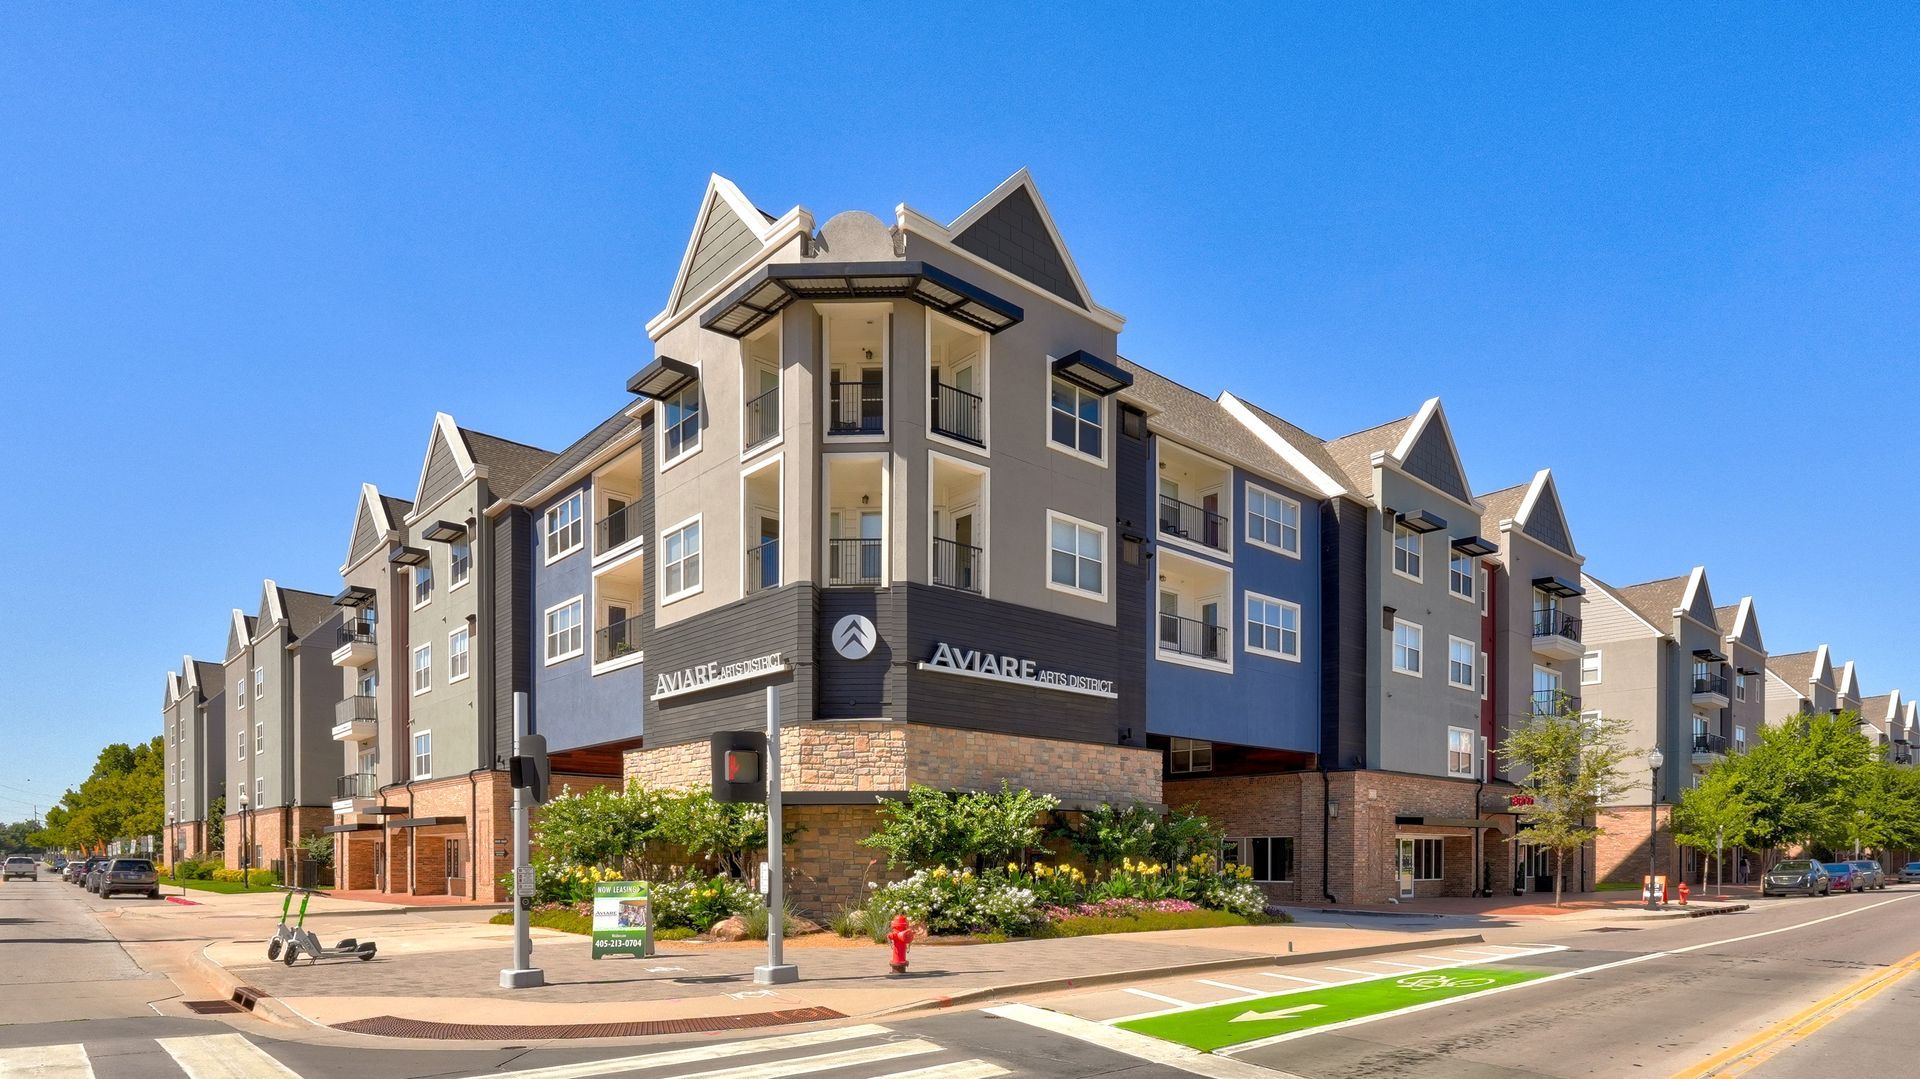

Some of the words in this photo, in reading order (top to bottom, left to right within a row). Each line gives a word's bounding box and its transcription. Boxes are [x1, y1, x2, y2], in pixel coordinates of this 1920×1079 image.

[655, 661, 719, 695] AVIARE
[720, 663, 742, 679] ARTS
[743, 652, 783, 672] DISTRICT
[930, 642, 1038, 681] AVIARE
[1039, 670, 1068, 686] ARTS
[1069, 674, 1114, 693] DISTRICT
[595, 939, 642, 948] 405-213-0704
